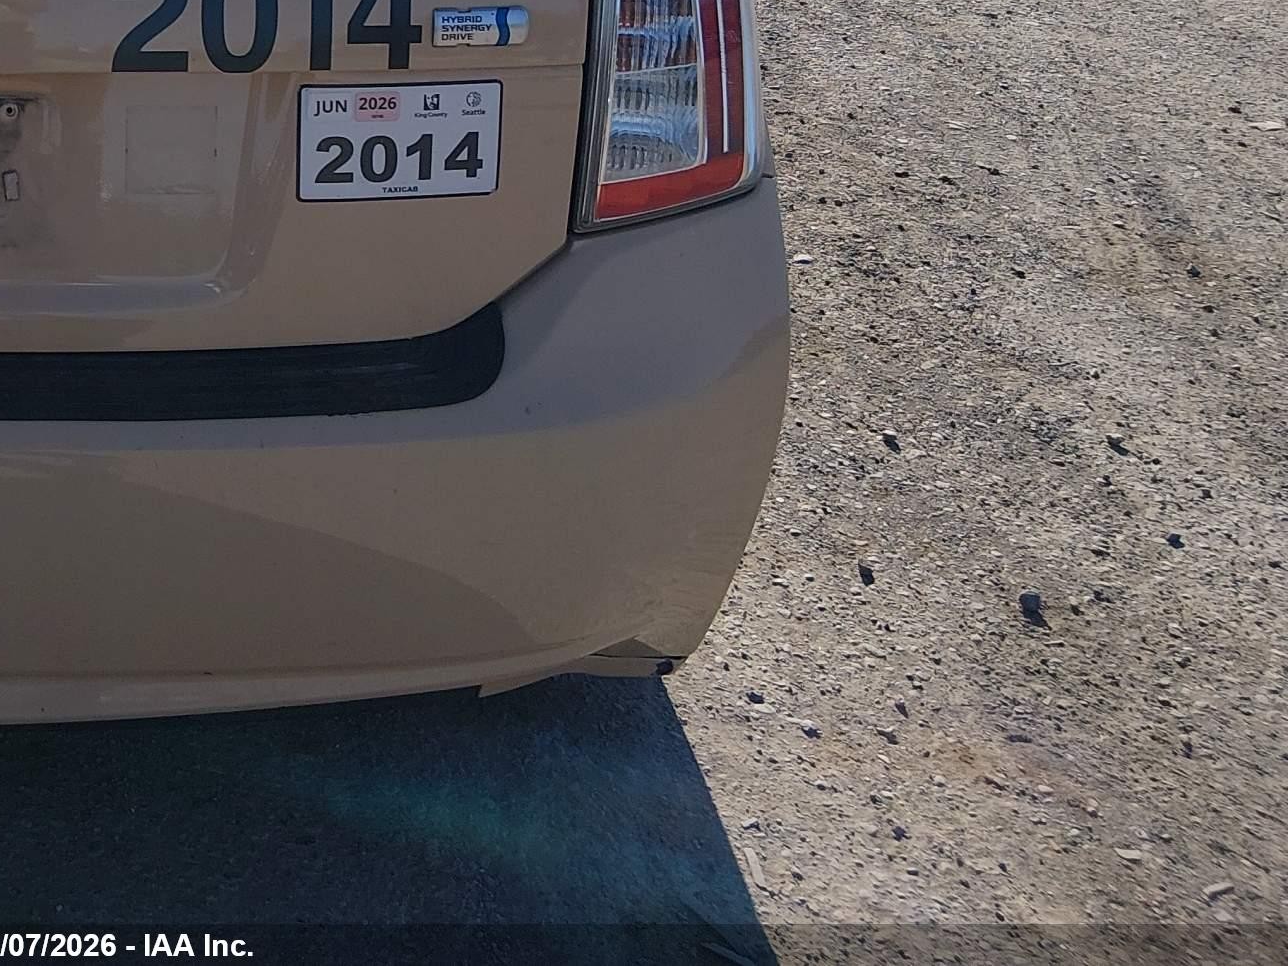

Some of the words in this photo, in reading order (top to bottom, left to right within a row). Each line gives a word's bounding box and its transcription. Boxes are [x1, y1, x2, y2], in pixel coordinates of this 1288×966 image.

[441, 15, 483, 24] HYBRID
[441, 23, 493, 33] SYNERGY
[441, 32, 474, 41] DRIVE
[313, 99, 348, 117] JUN
[358, 97, 398, 111] 2026
[461, 108, 486, 116] Seattle
[314, 132, 484, 184] 2014
